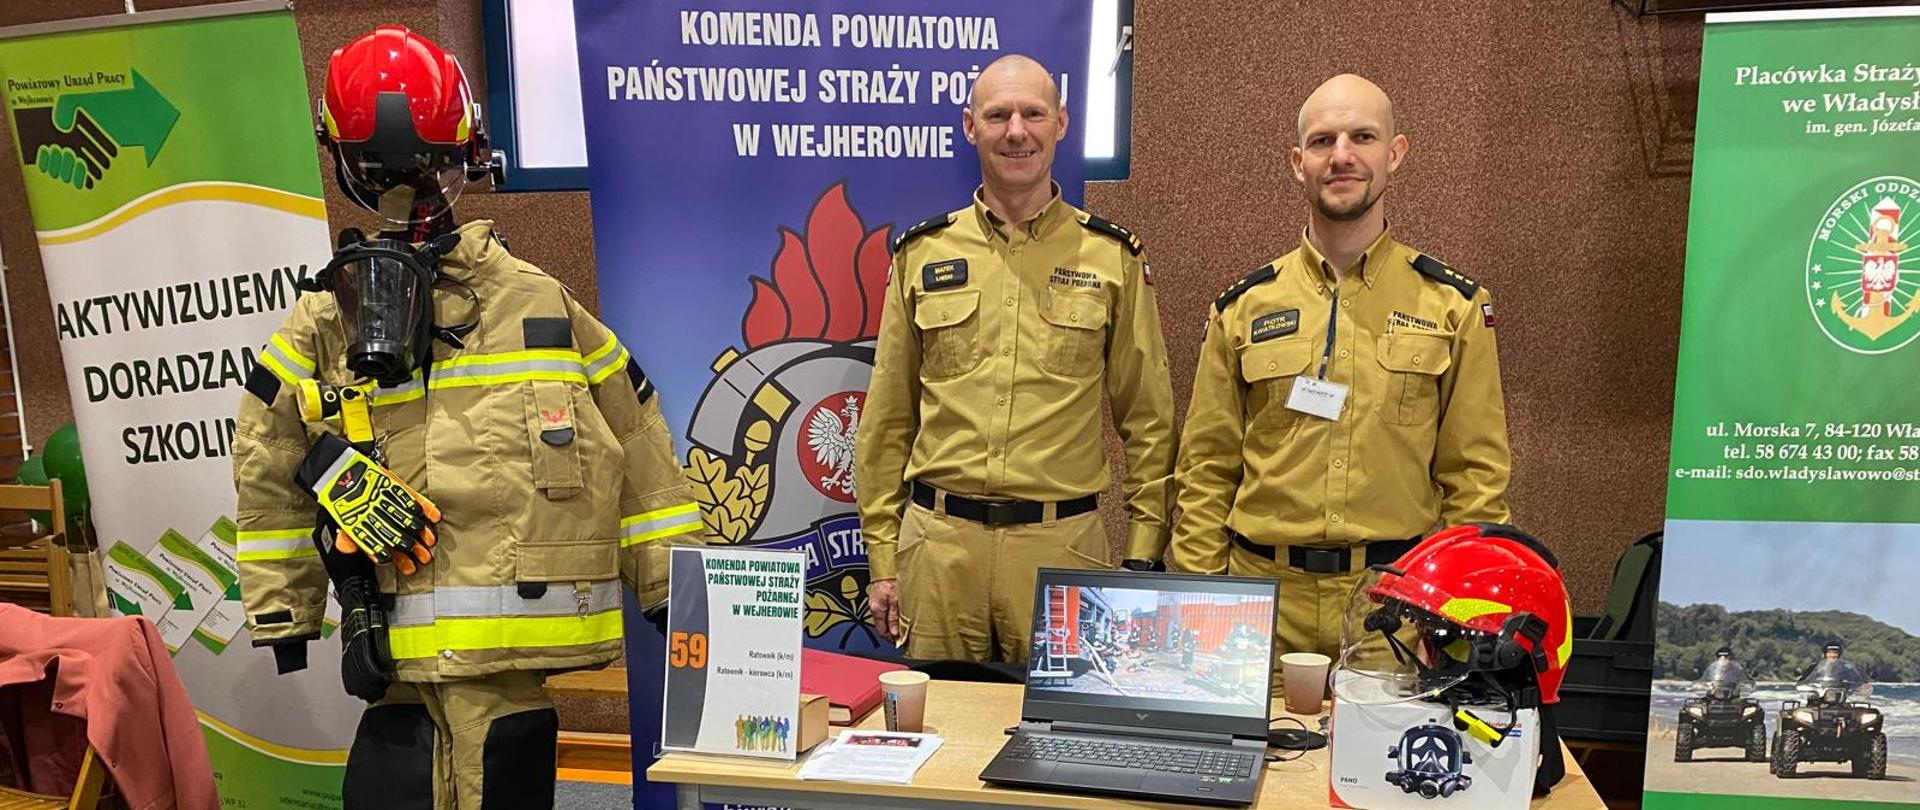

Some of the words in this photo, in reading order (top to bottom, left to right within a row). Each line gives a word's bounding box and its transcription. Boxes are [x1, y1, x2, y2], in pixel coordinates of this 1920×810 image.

[680, 11, 821, 47] KOMENDA
[832, 14, 999, 50] POWIATOWA
[607, 59, 807, 103] PAŃSTWOWEJ
[818, 64, 920, 104] STRAŻY
[1735, 64, 1846, 86] Placówka
[1782, 98, 1816, 113] we
[1806, 120, 1831, 134] im.
[1834, 122, 1867, 137] gen.
[1870, 118, 1920, 136] Józefa
[733, 124, 761, 156] W
[772, 124, 954, 158] WEJHEROWIE
[1817, 187, 1869, 242] MORSKI
[57, 264, 308, 341] AKTYWIZUJEMY
[1706, 423, 1728, 437] ul.
[1734, 422, 1800, 437] Morska
[1805, 423, 1820, 440] 7,
[1824, 423, 1882, 438] 84-120
[1723, 445, 1750, 459] tel.
[1755, 445, 1774, 459] 58
[1779, 445, 1808, 459] 674
[1812, 445, 1832, 459] 43
[1837, 445, 1863, 462] 00;
[1867, 445, 1895, 460] fax
[1898, 445, 1920, 461] 58
[1675, 466, 1732, 479] e-mail:
[828, 528, 868, 559] STR
[705, 558, 747, 571] KOMENDA
[749, 560, 801, 573] POWIATOWA
[708, 571, 767, 587] PAŃSTWOWEJ
[768, 575, 800, 588] STRAŻY
[756, 589, 799, 604] POŻARNEJ
[732, 604, 740, 615] W
[743, 604, 799, 618] WEJHEROWIE
[670, 631, 707, 669] 59
